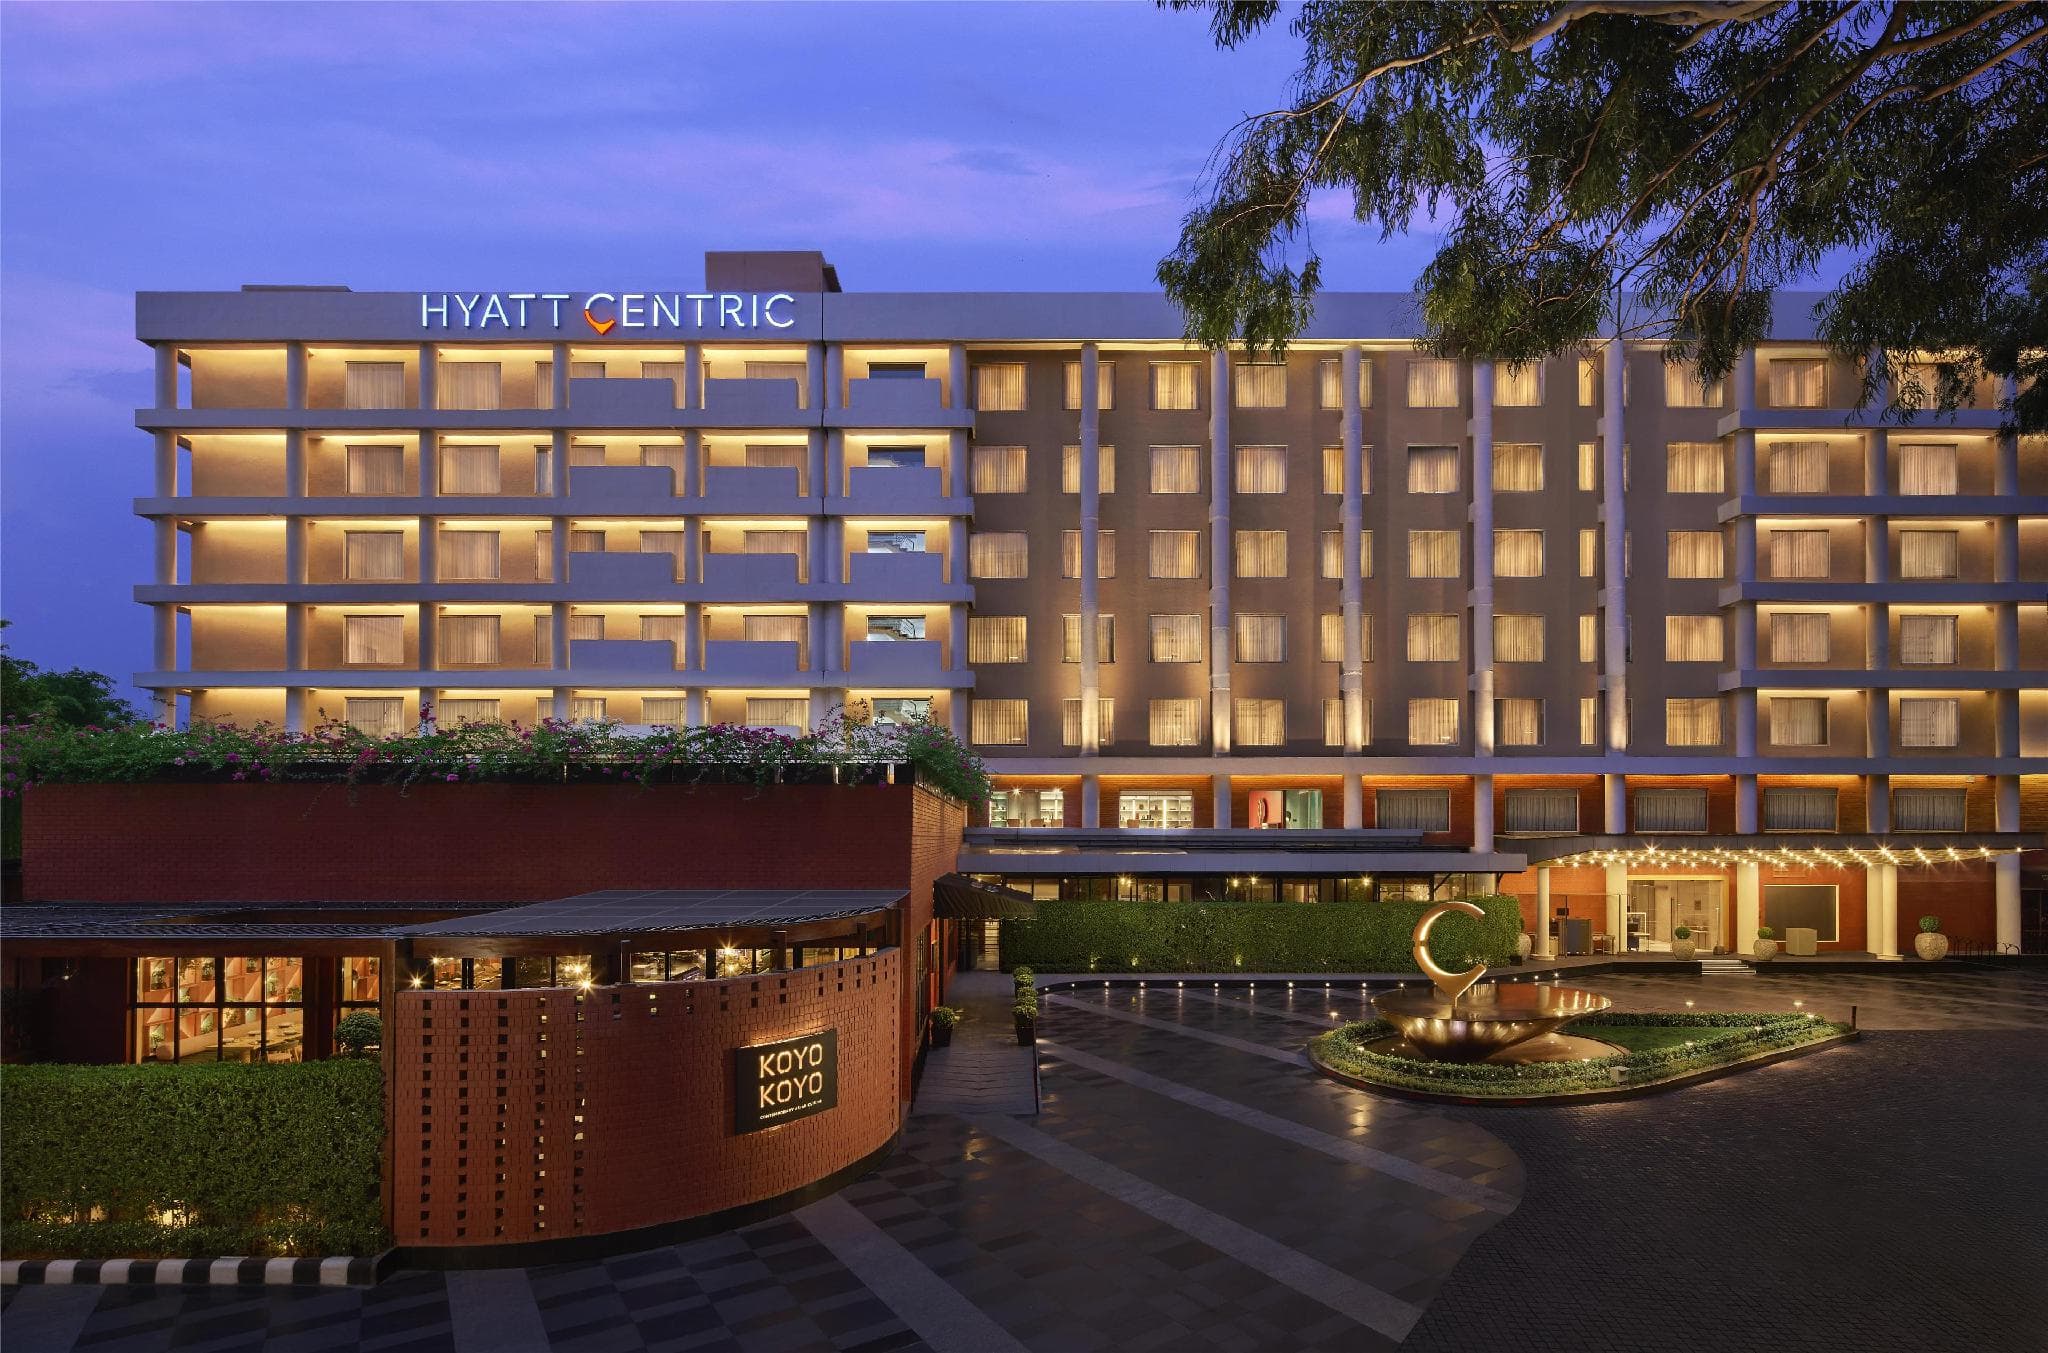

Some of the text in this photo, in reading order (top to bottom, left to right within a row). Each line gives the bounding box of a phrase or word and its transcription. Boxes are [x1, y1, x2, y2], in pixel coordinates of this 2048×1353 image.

[421, 293, 796, 335] HYATT CENTRIC
[759, 1043, 823, 1079] KOYO
[759, 1071, 823, 1109] KOYO
